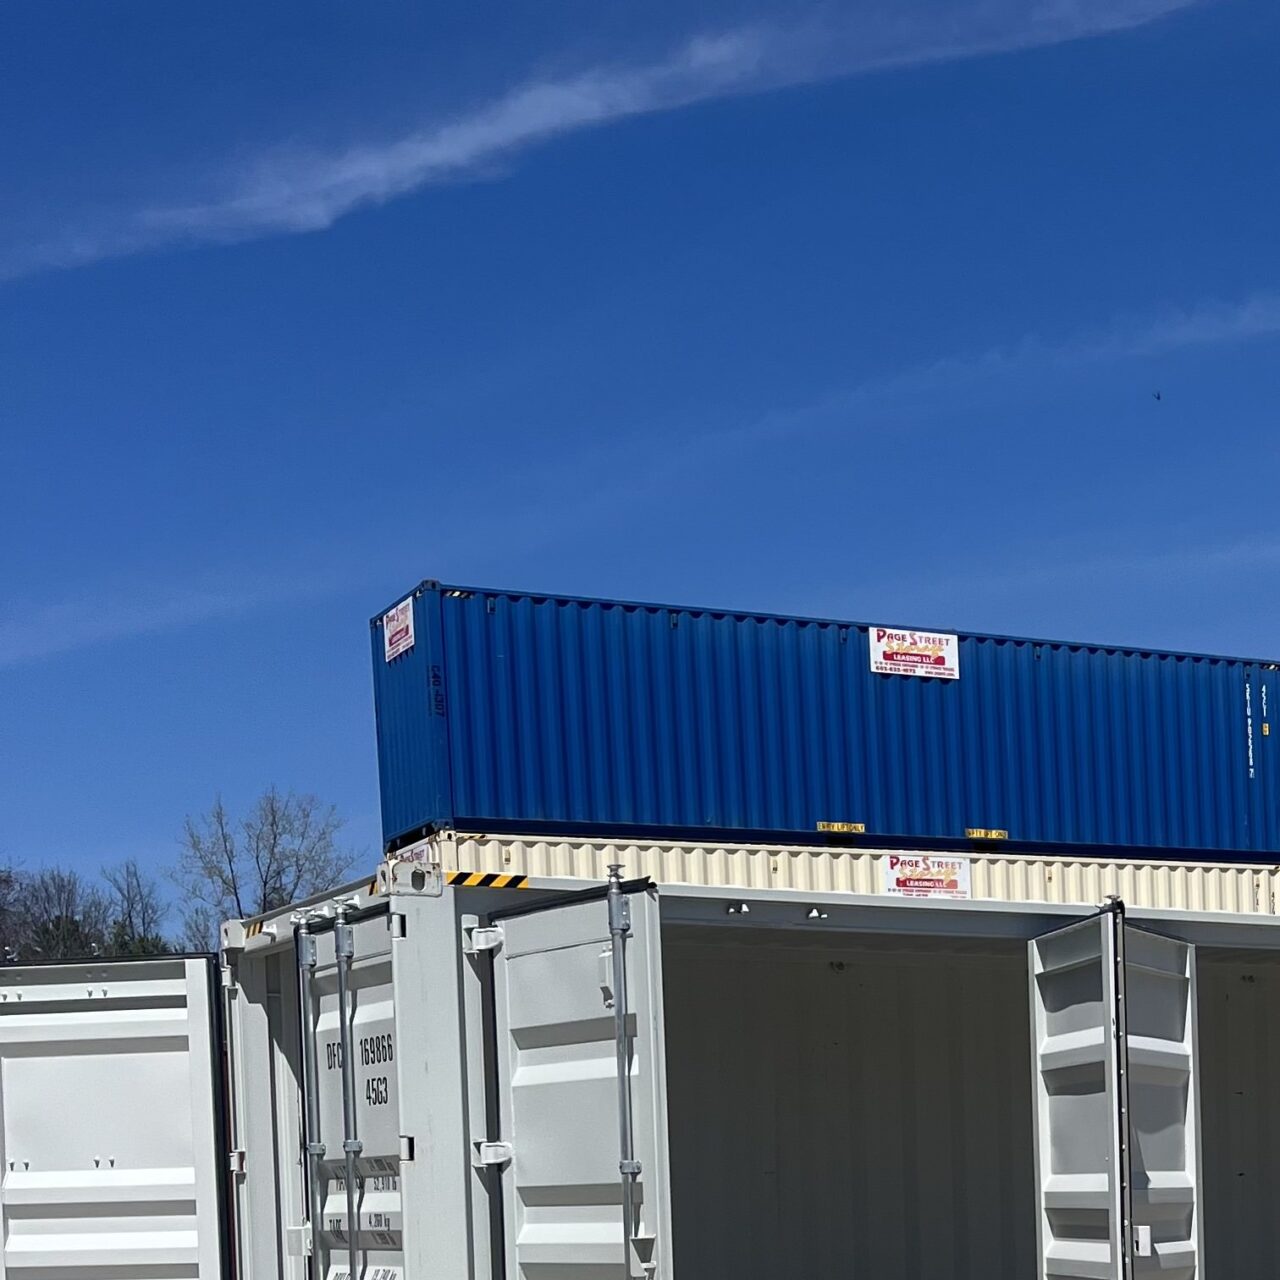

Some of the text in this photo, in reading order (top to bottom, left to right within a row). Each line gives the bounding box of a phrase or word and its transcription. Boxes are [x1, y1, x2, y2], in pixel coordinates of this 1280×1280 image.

[877, 629, 950, 646] PAGE STREET
[893, 654, 921, 662] LEASING
[889, 855, 963, 871] PAGE STREET
[906, 880, 934, 888] LEASING
[360, 1034, 393, 1066] 169866
[366, 1077, 388, 1106] 45G3
